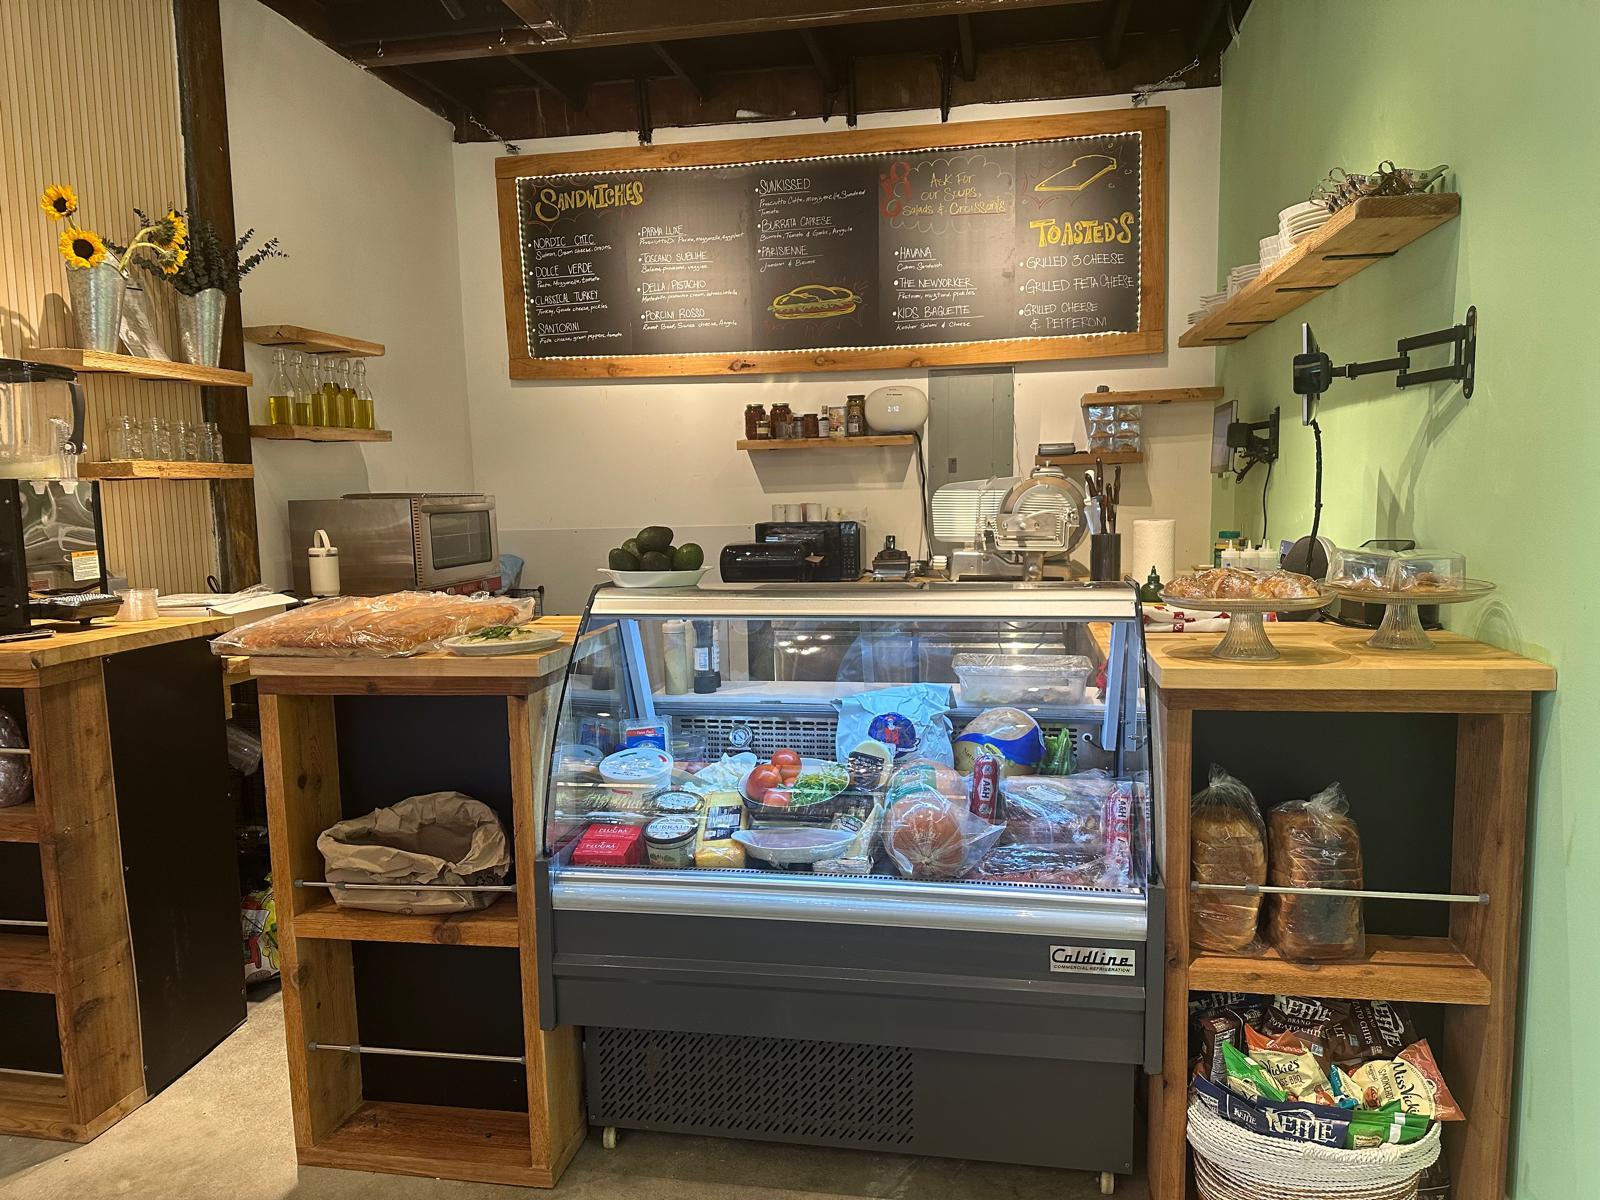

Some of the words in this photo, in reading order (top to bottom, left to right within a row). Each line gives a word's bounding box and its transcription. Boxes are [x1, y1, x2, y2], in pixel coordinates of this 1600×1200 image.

[955, 171, 977, 184] For
[759, 178, 811, 195] SUNKISSED
[920, 191, 941, 201] our
[902, 203, 934, 217] Salads
[949, 195, 1007, 216] Croissants
[641, 226, 663, 237] PARMA
[761, 219, 797, 232] BURRATA
[800, 216, 834, 227] CAPRESE
[1029, 211, 1134, 248] TOASTED'S
[534, 236, 566, 249] NORDIC
[641, 252, 672, 263] TOSCANO
[676, 250, 708, 262] SUBLIME
[761, 245, 808, 257] PARISIENNE
[900, 246, 932, 260] HAVANA
[1026, 256, 1068, 270] GRILLED
[1071, 254, 1082, 267] 3
[1082, 252, 1126, 266] CHEESE
[535, 265, 559, 278] DOLCE
[567, 262, 593, 275] VERDE
[642, 282, 666, 294] DELLA
[671, 280, 706, 290] PISTACHIO
[898, 277, 917, 289] THE
[1025, 278, 1070, 295] GRILLED
[1073, 276, 1099, 291] FETA
[1100, 273, 1135, 289] CHEESE
[535, 293, 570, 305] CLASSICAL
[573, 290, 599, 302] TURKEY
[645, 310, 674, 323] PORCINI
[678, 308, 705, 319] ROSSO
[897, 306, 920, 319] KIDS
[1024, 303, 1057, 317] GRILLED
[1061, 301, 1099, 313] CHEESE
[538, 321, 580, 335] SANTORINI
[1029, 318, 1041, 332] &
[1046, 316, 1107, 330] PEPPERONI
[981, 780, 992, 799] A&H
[1053, 964, 1089, 972] COMMERCIAL
[1268, 1016, 1300, 1032] POTATO
[1287, 1017, 1311, 1025] BRAND
[1360, 1020, 1373, 1045] CHIPS
[1378, 1068, 1395, 1100] SMOKEHO
[1263, 1107, 1337, 1143] KETTLE
